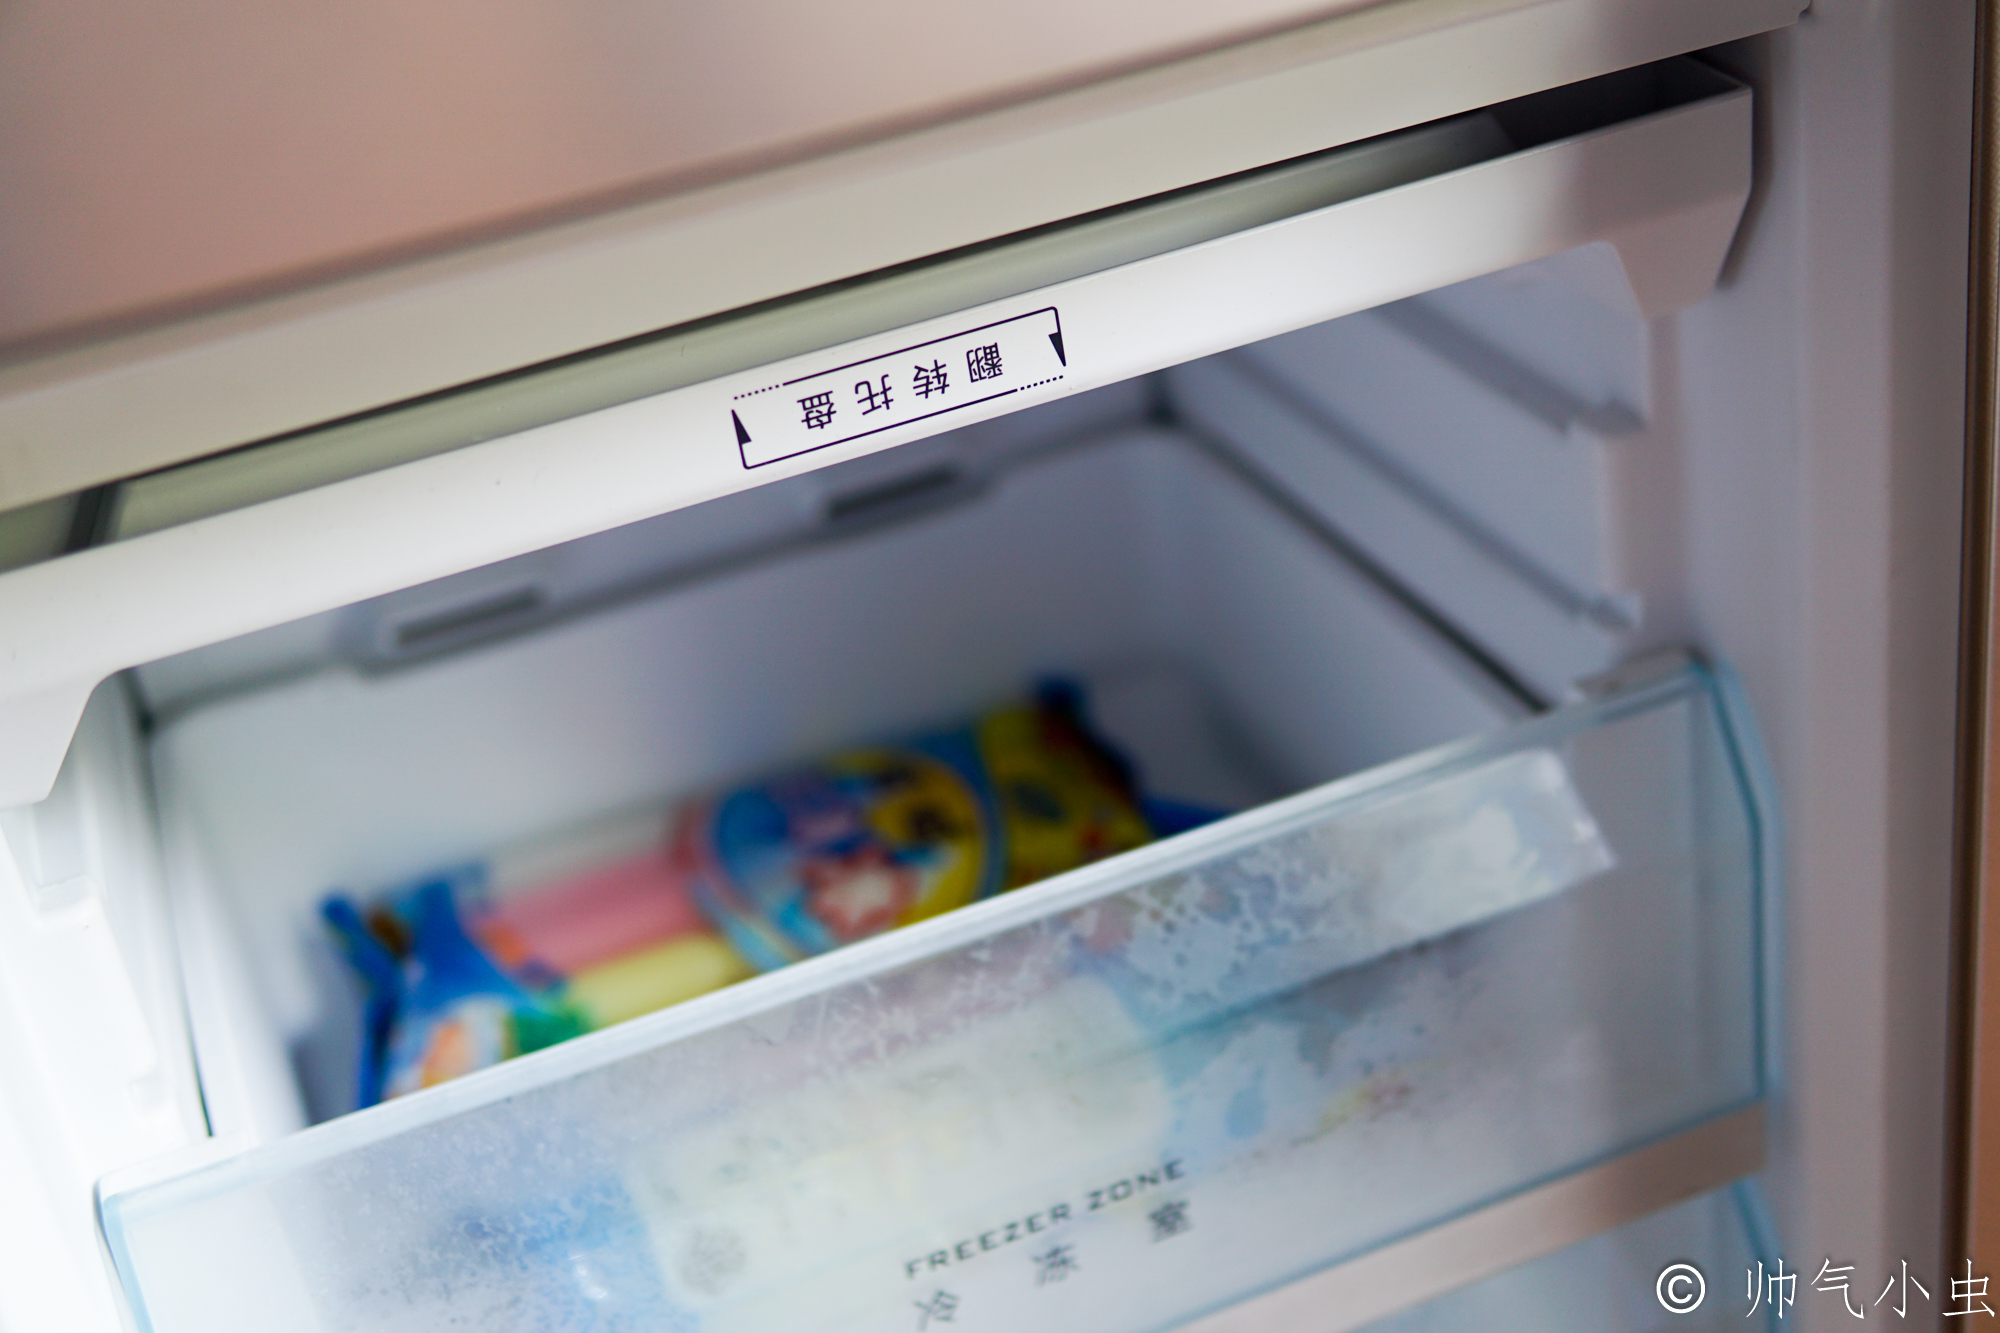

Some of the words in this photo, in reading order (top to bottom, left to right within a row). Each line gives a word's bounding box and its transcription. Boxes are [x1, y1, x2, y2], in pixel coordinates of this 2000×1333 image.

[797, 343, 1003, 429] 翻转托盘
[905, 1203, 1073, 1279] FREEZER
[1086, 1158, 1187, 1212] ZONE
[912, 1201, 1192, 1331] 冷冻室
